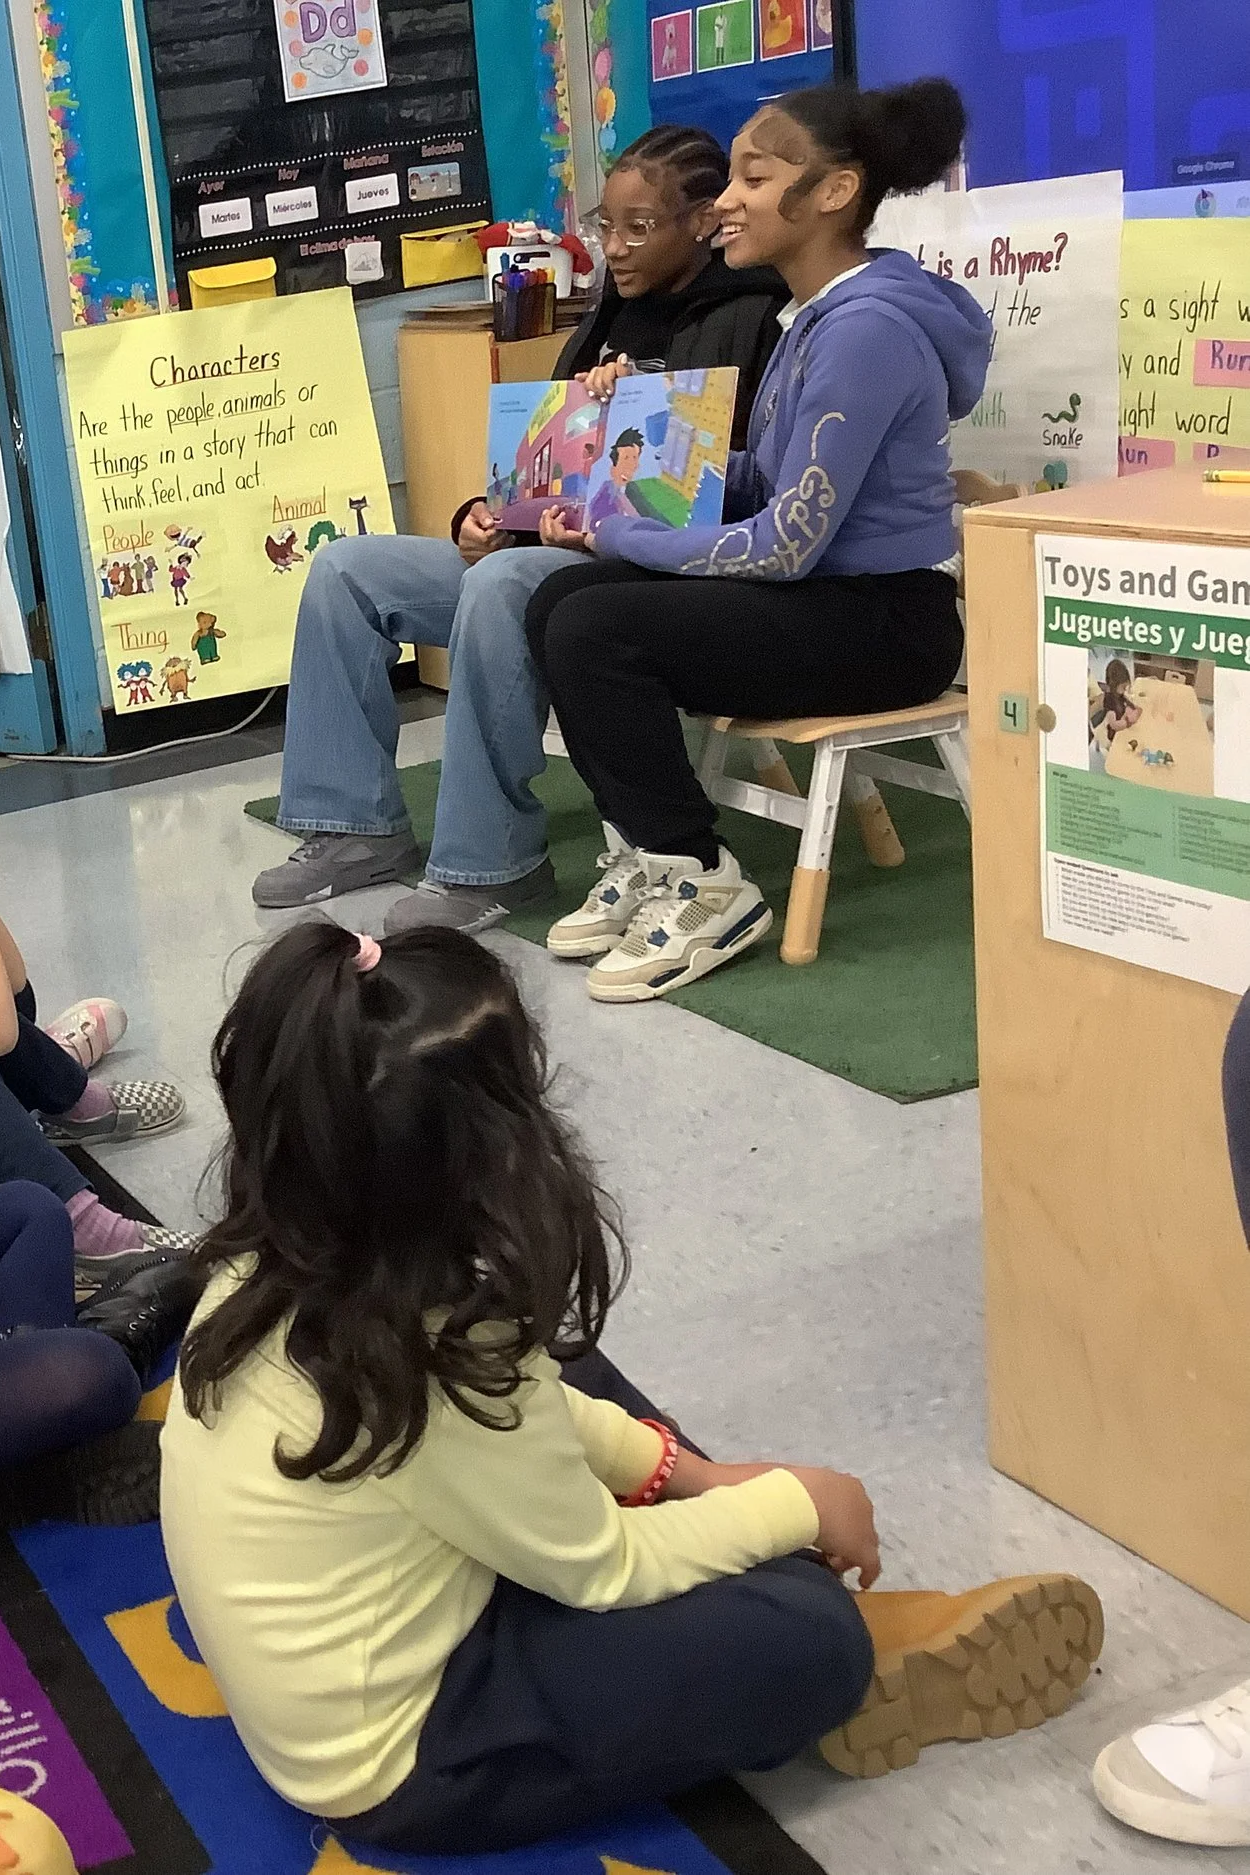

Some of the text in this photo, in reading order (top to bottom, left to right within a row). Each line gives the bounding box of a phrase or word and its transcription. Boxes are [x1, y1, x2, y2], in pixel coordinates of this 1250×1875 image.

[277, 168, 300, 182] Hoy
[343, 154, 390, 171] Mañana
[198, 180, 225, 194] Ayer
[356, 186, 390, 201] Jueves
[211, 210, 241, 224] Martes
[272, 201, 313, 215] Miércoles
[309, 240, 338, 255] clima
[937, 251, 953, 279] is
[964, 257, 979, 279] a
[990, 232, 1068, 285] Rhyme?
[1007, 289, 1042, 326] the
[1143, 298, 1156, 318] a
[1168, 280, 1222, 333] sight
[150, 344, 280, 389] Characters
[1143, 338, 1182, 376] and
[78, 410, 108, 440] Are
[119, 404, 154, 431] the
[223, 378, 286, 416] animals
[297, 384, 318, 402] or
[1118, 390, 1232, 437] ight word
[89, 415, 337, 480] things in a story that can
[192, 467, 226, 499] and
[271, 486, 327, 523] Animal
[102, 520, 154, 554] People
[1045, 557, 1110, 596] Toys
[1119, 566, 1176, 598] and
[112, 622, 170, 653] Thing
[1049, 606, 1162, 643] Juguetes
[1169, 626, 1185, 654] y
[1004, 701, 1017, 727] 4
